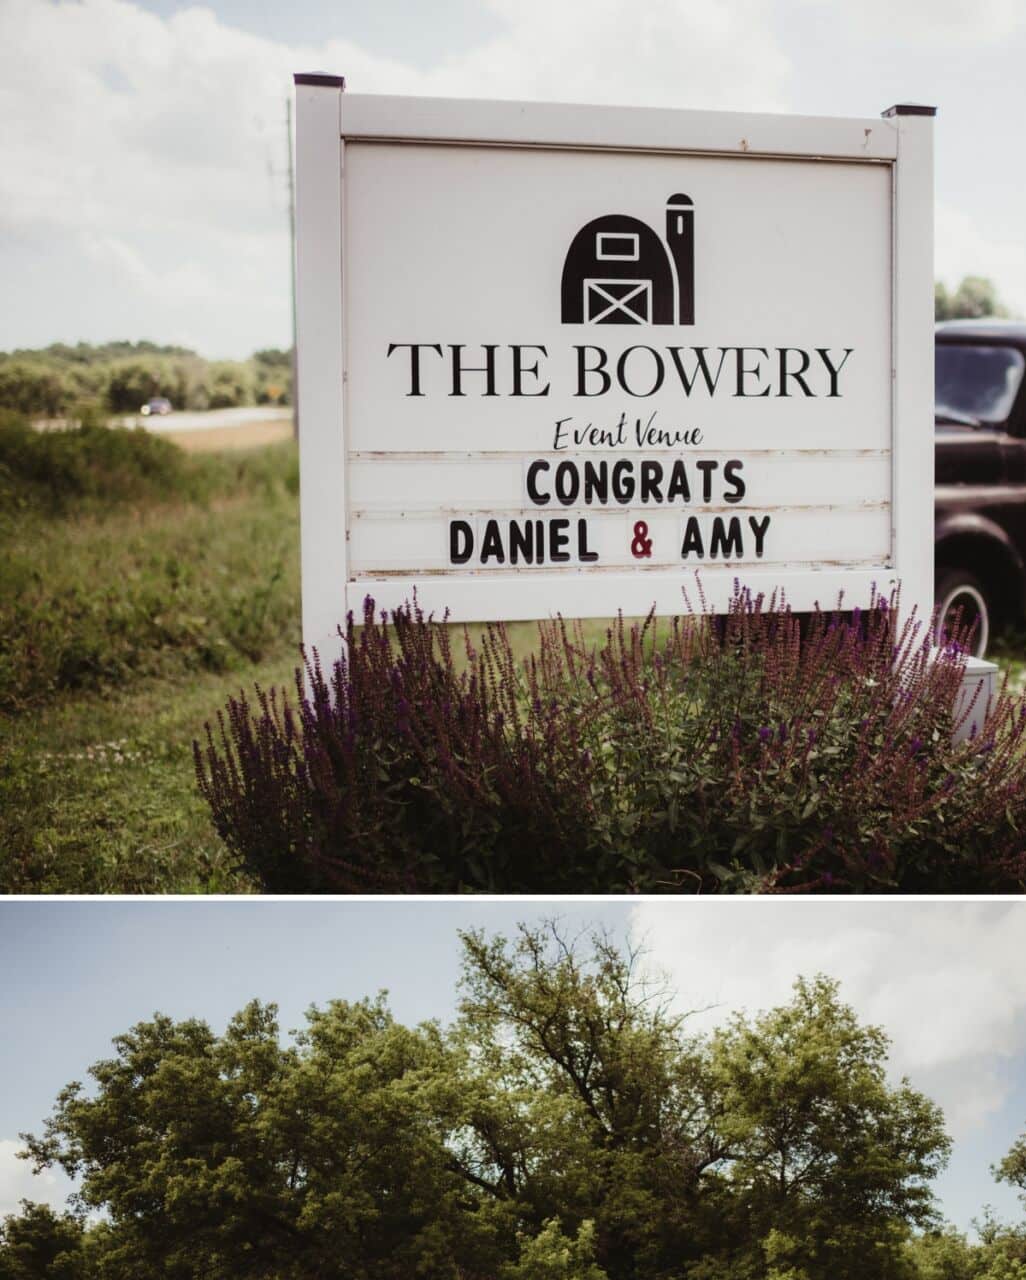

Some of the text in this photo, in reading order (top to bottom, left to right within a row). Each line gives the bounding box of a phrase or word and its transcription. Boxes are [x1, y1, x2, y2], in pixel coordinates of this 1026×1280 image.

[387, 343, 855, 399] THE BOWERY
[553, 411, 704, 451] Event Venue
[526, 458, 747, 505] CONGRATS
[449, 516, 772, 565] DANIEL & AMY
